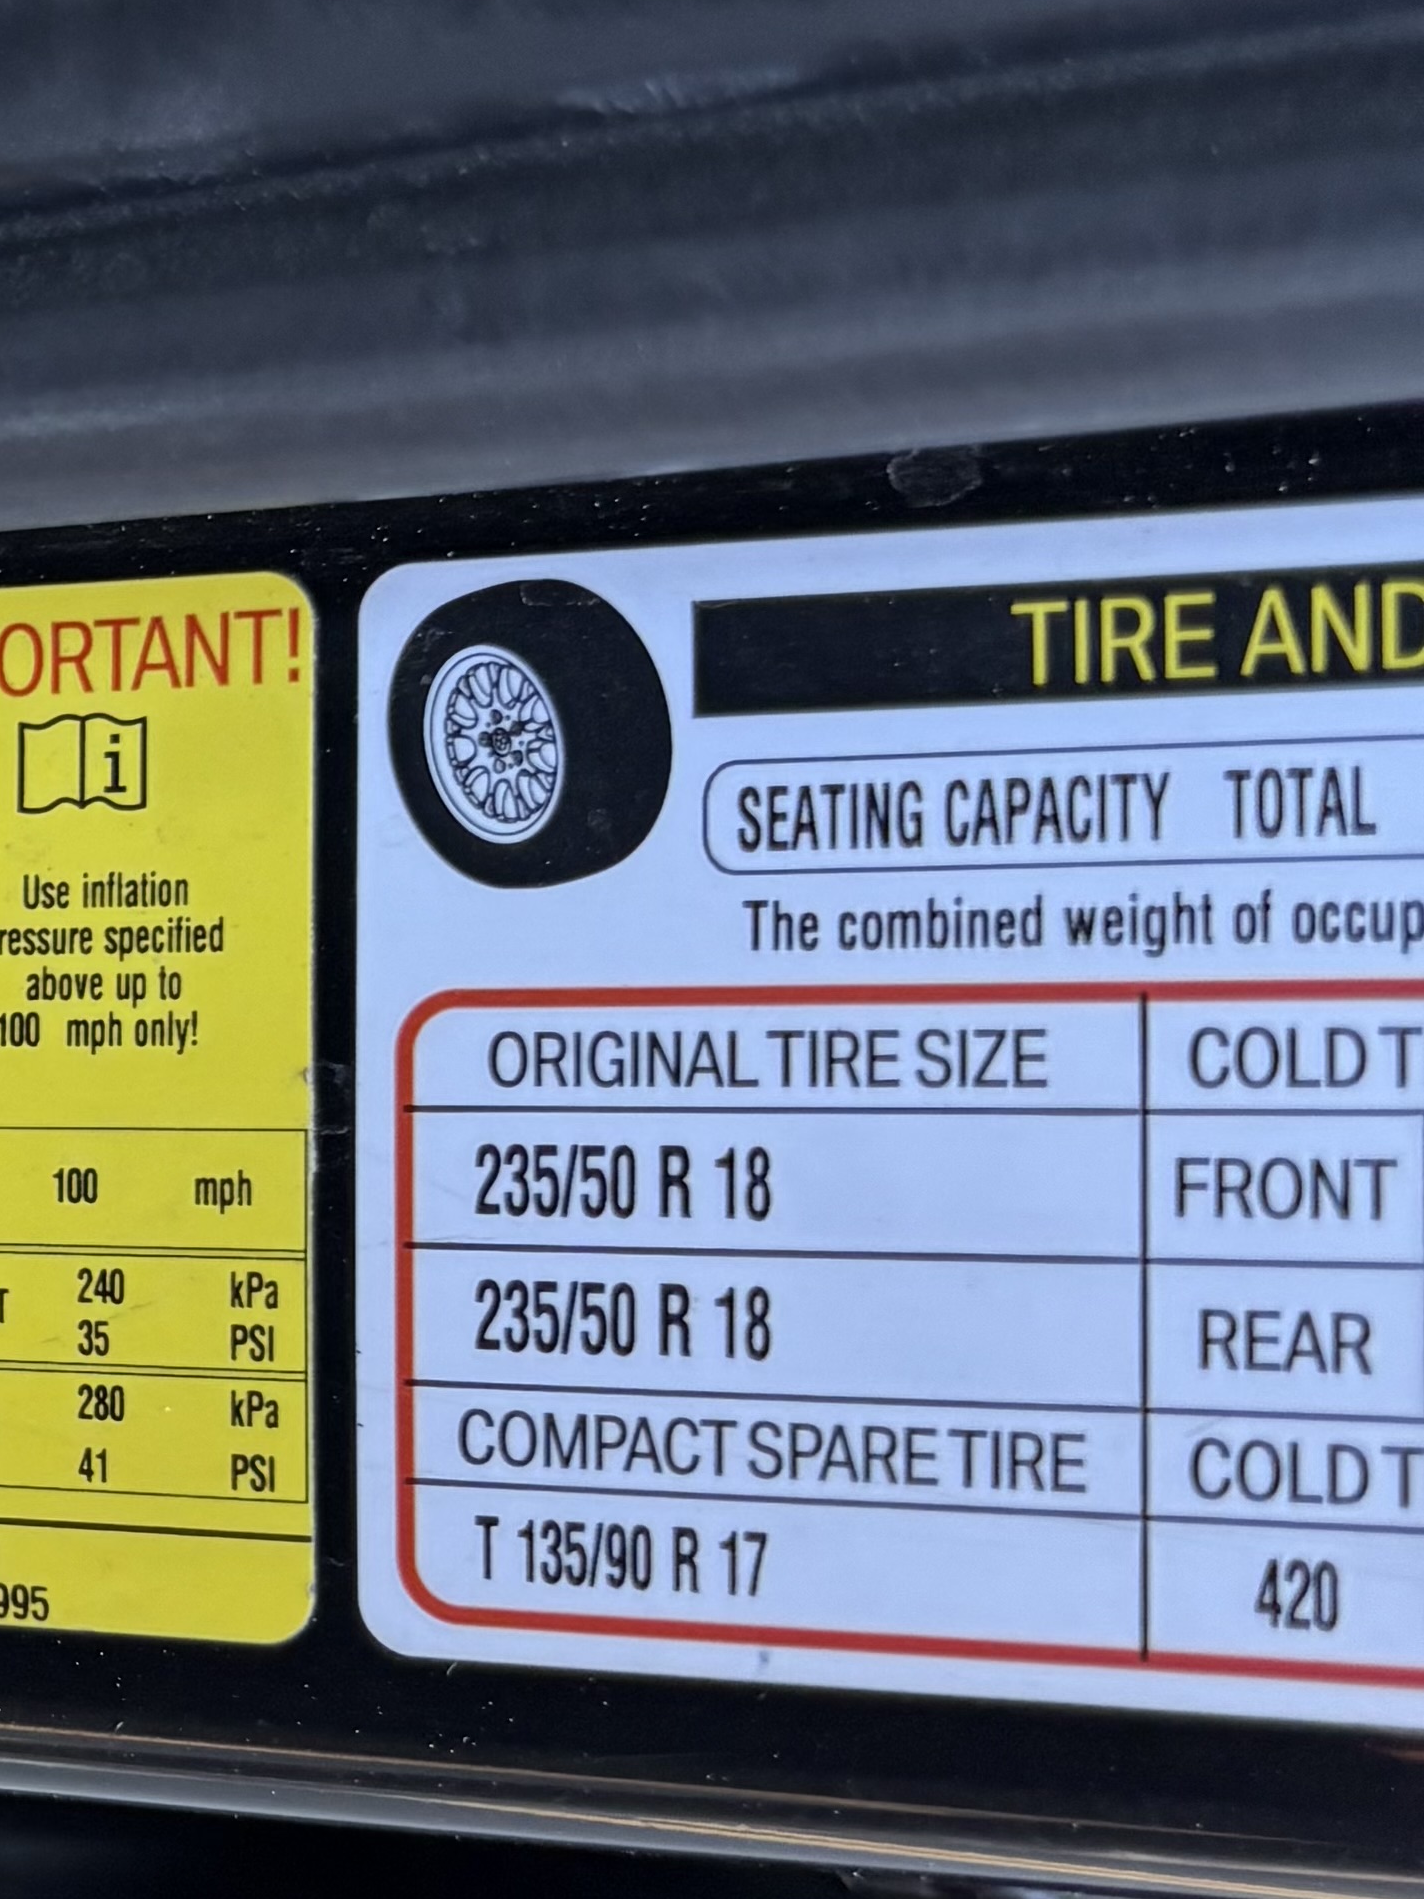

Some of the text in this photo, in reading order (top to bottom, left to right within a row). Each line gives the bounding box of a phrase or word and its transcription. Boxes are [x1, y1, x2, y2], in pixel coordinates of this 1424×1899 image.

[1012, 580, 1424, 687] TIRE AND
[738, 765, 1377, 853] SEATING CAPACITY TOTAL
[23, 870, 189, 910] Use inflation
[104, 916, 224, 962] specified
[742, 899, 819, 952] The
[838, 894, 1043, 951] combined
[1064, 891, 1213, 958] weight
[1235, 888, 1271, 944] of
[26, 965, 182, 1009] above up to
[66, 1011, 123, 1056] mph
[134, 1010, 198, 1056] only!
[488, 1028, 1048, 1088] ORIGINAL TIRE SIZE
[1189, 1026, 1367, 1089] COLD
[53, 1167, 98, 1204] 100
[194, 1169, 252, 1215] mph
[476, 1143, 771, 1222] 235/50 R 18
[1175, 1157, 1398, 1220] FRONT
[77, 1267, 125, 1305] 240
[230, 1271, 279, 1310] kPa
[476, 1278, 771, 1362] 235/50 R 18
[78, 1319, 274, 1362] 35 PSI
[1200, 1308, 1372, 1375] REAR
[78, 1383, 125, 1422] 280
[230, 1389, 279, 1429] kPa
[78, 1447, 275, 1493] 41 PSI
[458, 1408, 1086, 1493] COMPACT SPARE TIRE
[1189, 1437, 1370, 1505] COLD
[474, 1515, 768, 1597] T 135/90 R 17
[1257, 1559, 1338, 1631] 420
